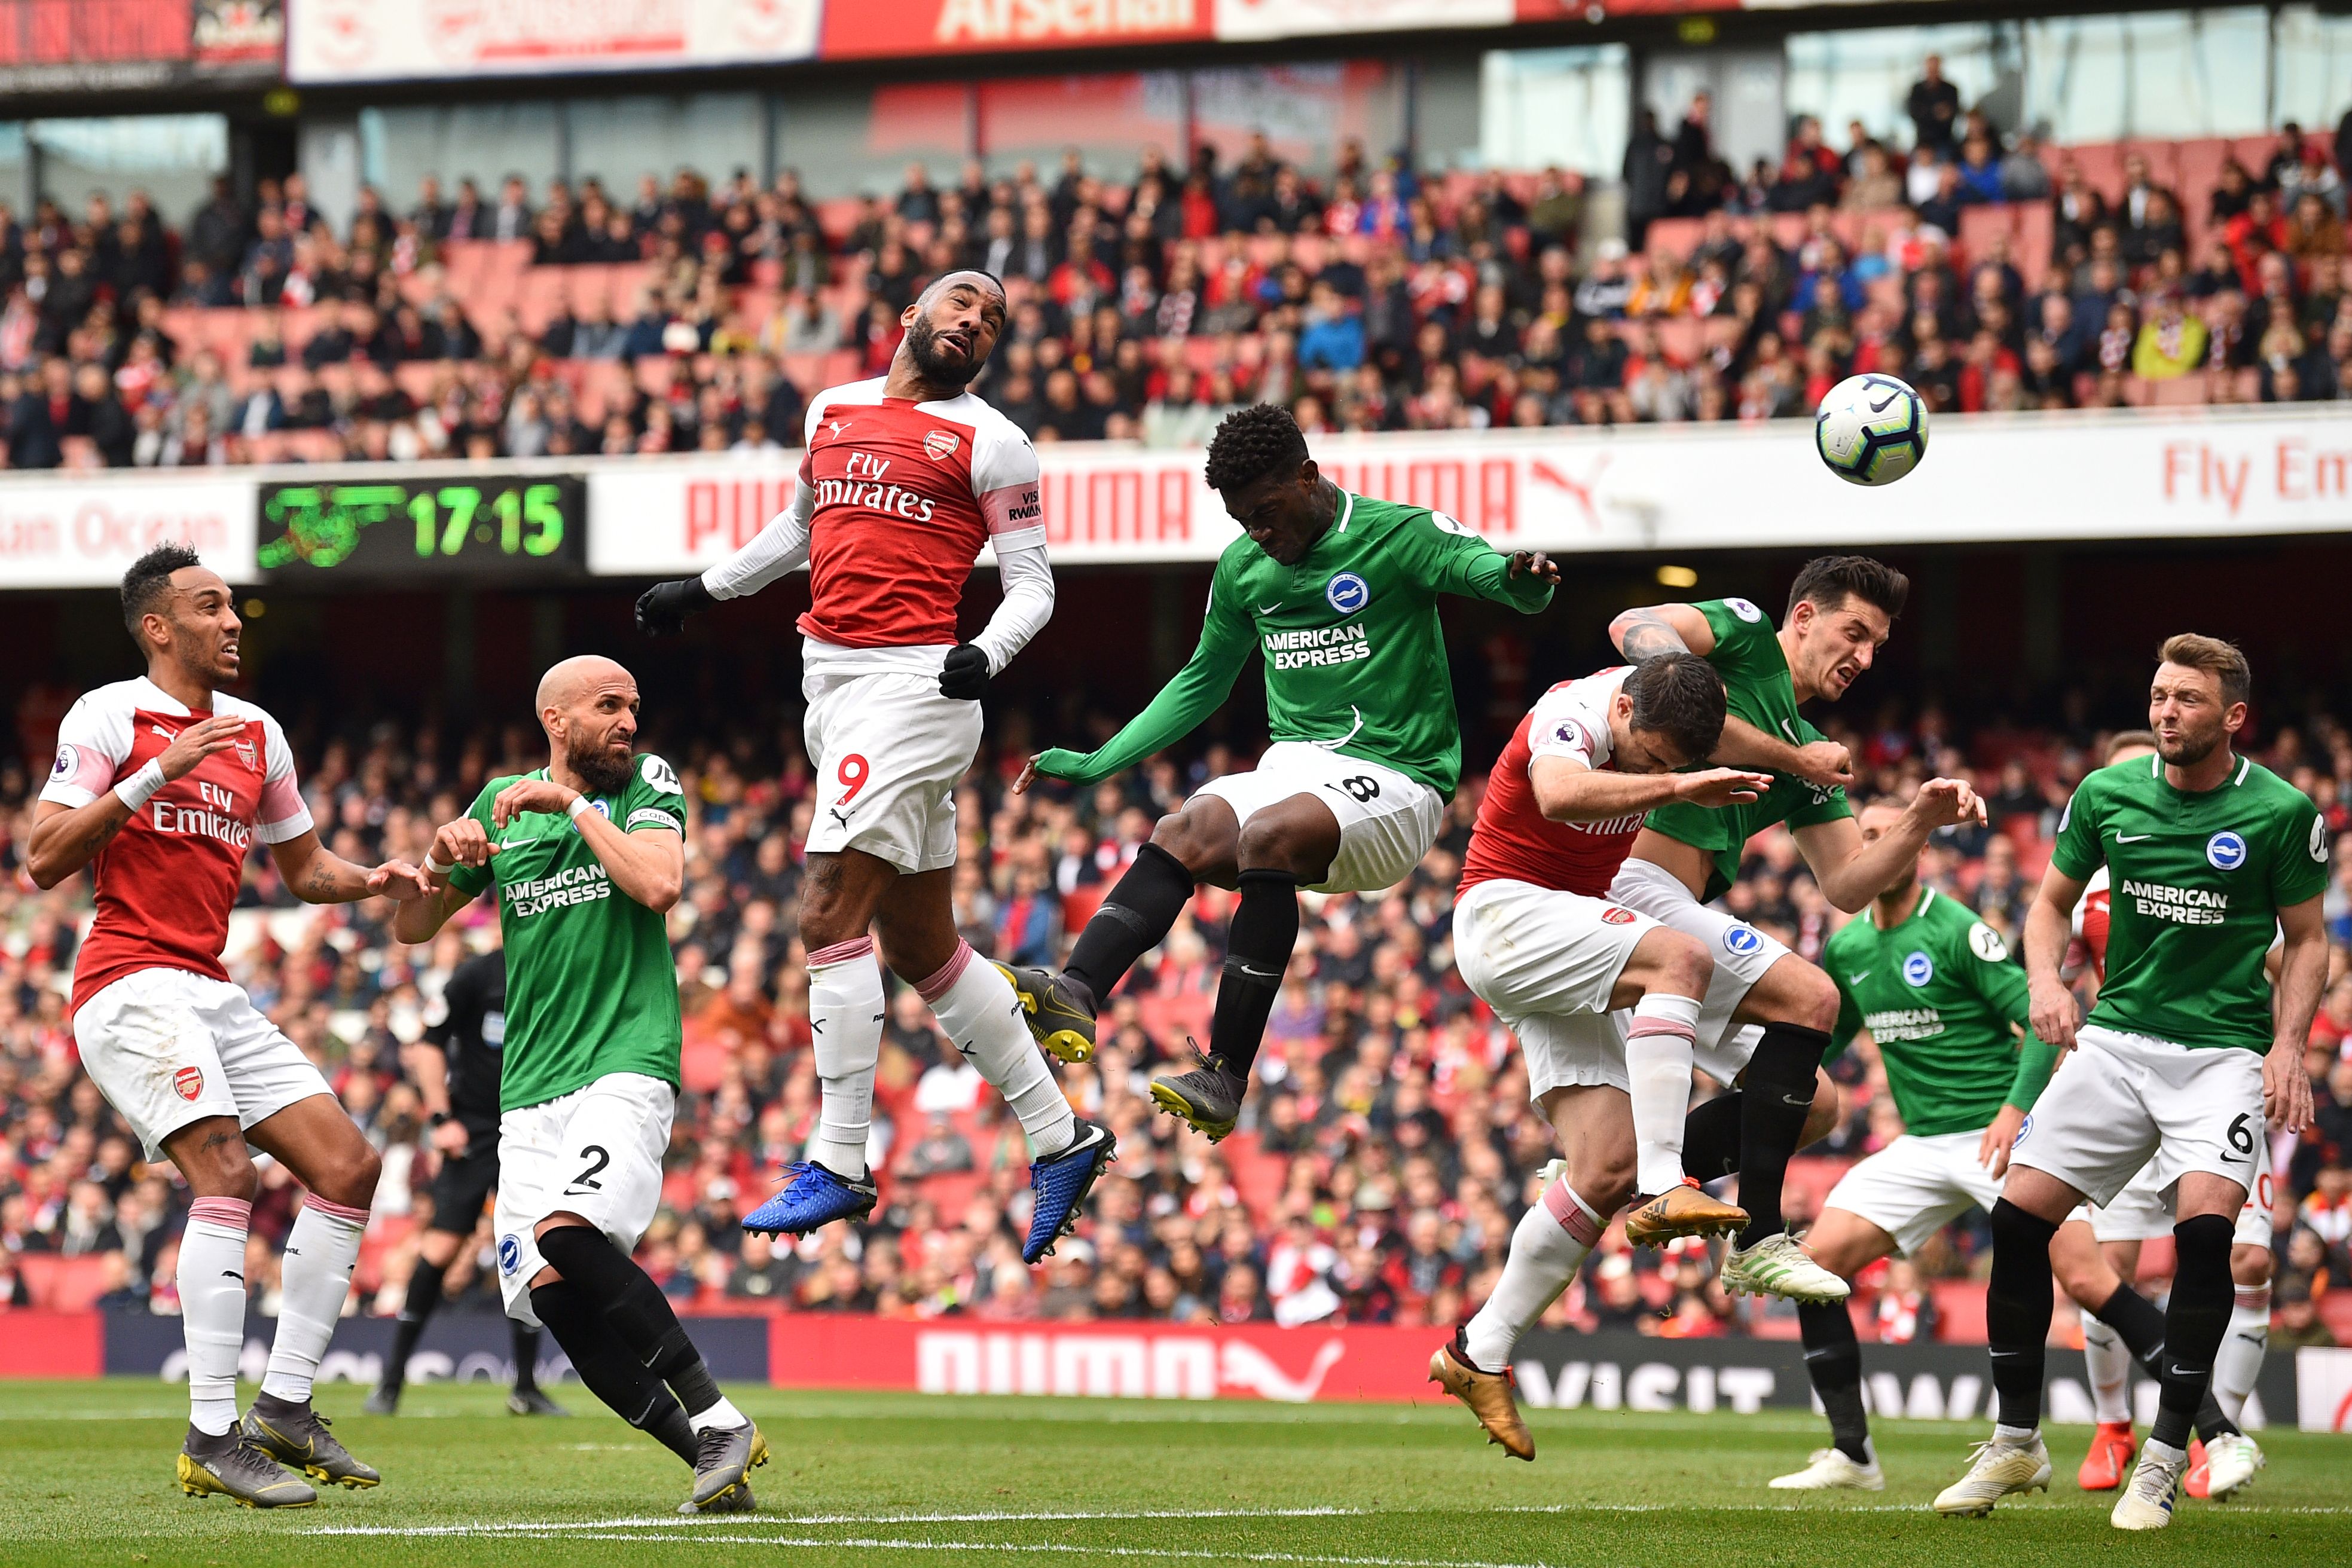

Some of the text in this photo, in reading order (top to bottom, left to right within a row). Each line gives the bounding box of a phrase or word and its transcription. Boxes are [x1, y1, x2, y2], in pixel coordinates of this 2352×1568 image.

[847, 452, 890, 480] Fly
[2164, 441, 2250, 515] Fly
[1040, 467, 1191, 543] UMA
[1265, 622, 1366, 650] AMERICAN
[1275, 640, 1370, 670] EXPRESS
[200, 781, 233, 812] Fly
[836, 753, 869, 805] 9
[1342, 775, 1380, 803] 8
[152, 800, 252, 849] Emirates
[506, 864, 607, 902] AMERICAN
[515, 881, 611, 918] EXPRESS
[2122, 879, 2228, 909] AMERICAN
[2136, 899, 2225, 925] EXPRESS
[1872, 1022, 1945, 1044] EXPRESS
[2227, 1112, 2253, 1154] 6
[571, 1145, 610, 1190] 2
[2243, 1173, 2273, 1210] 0
